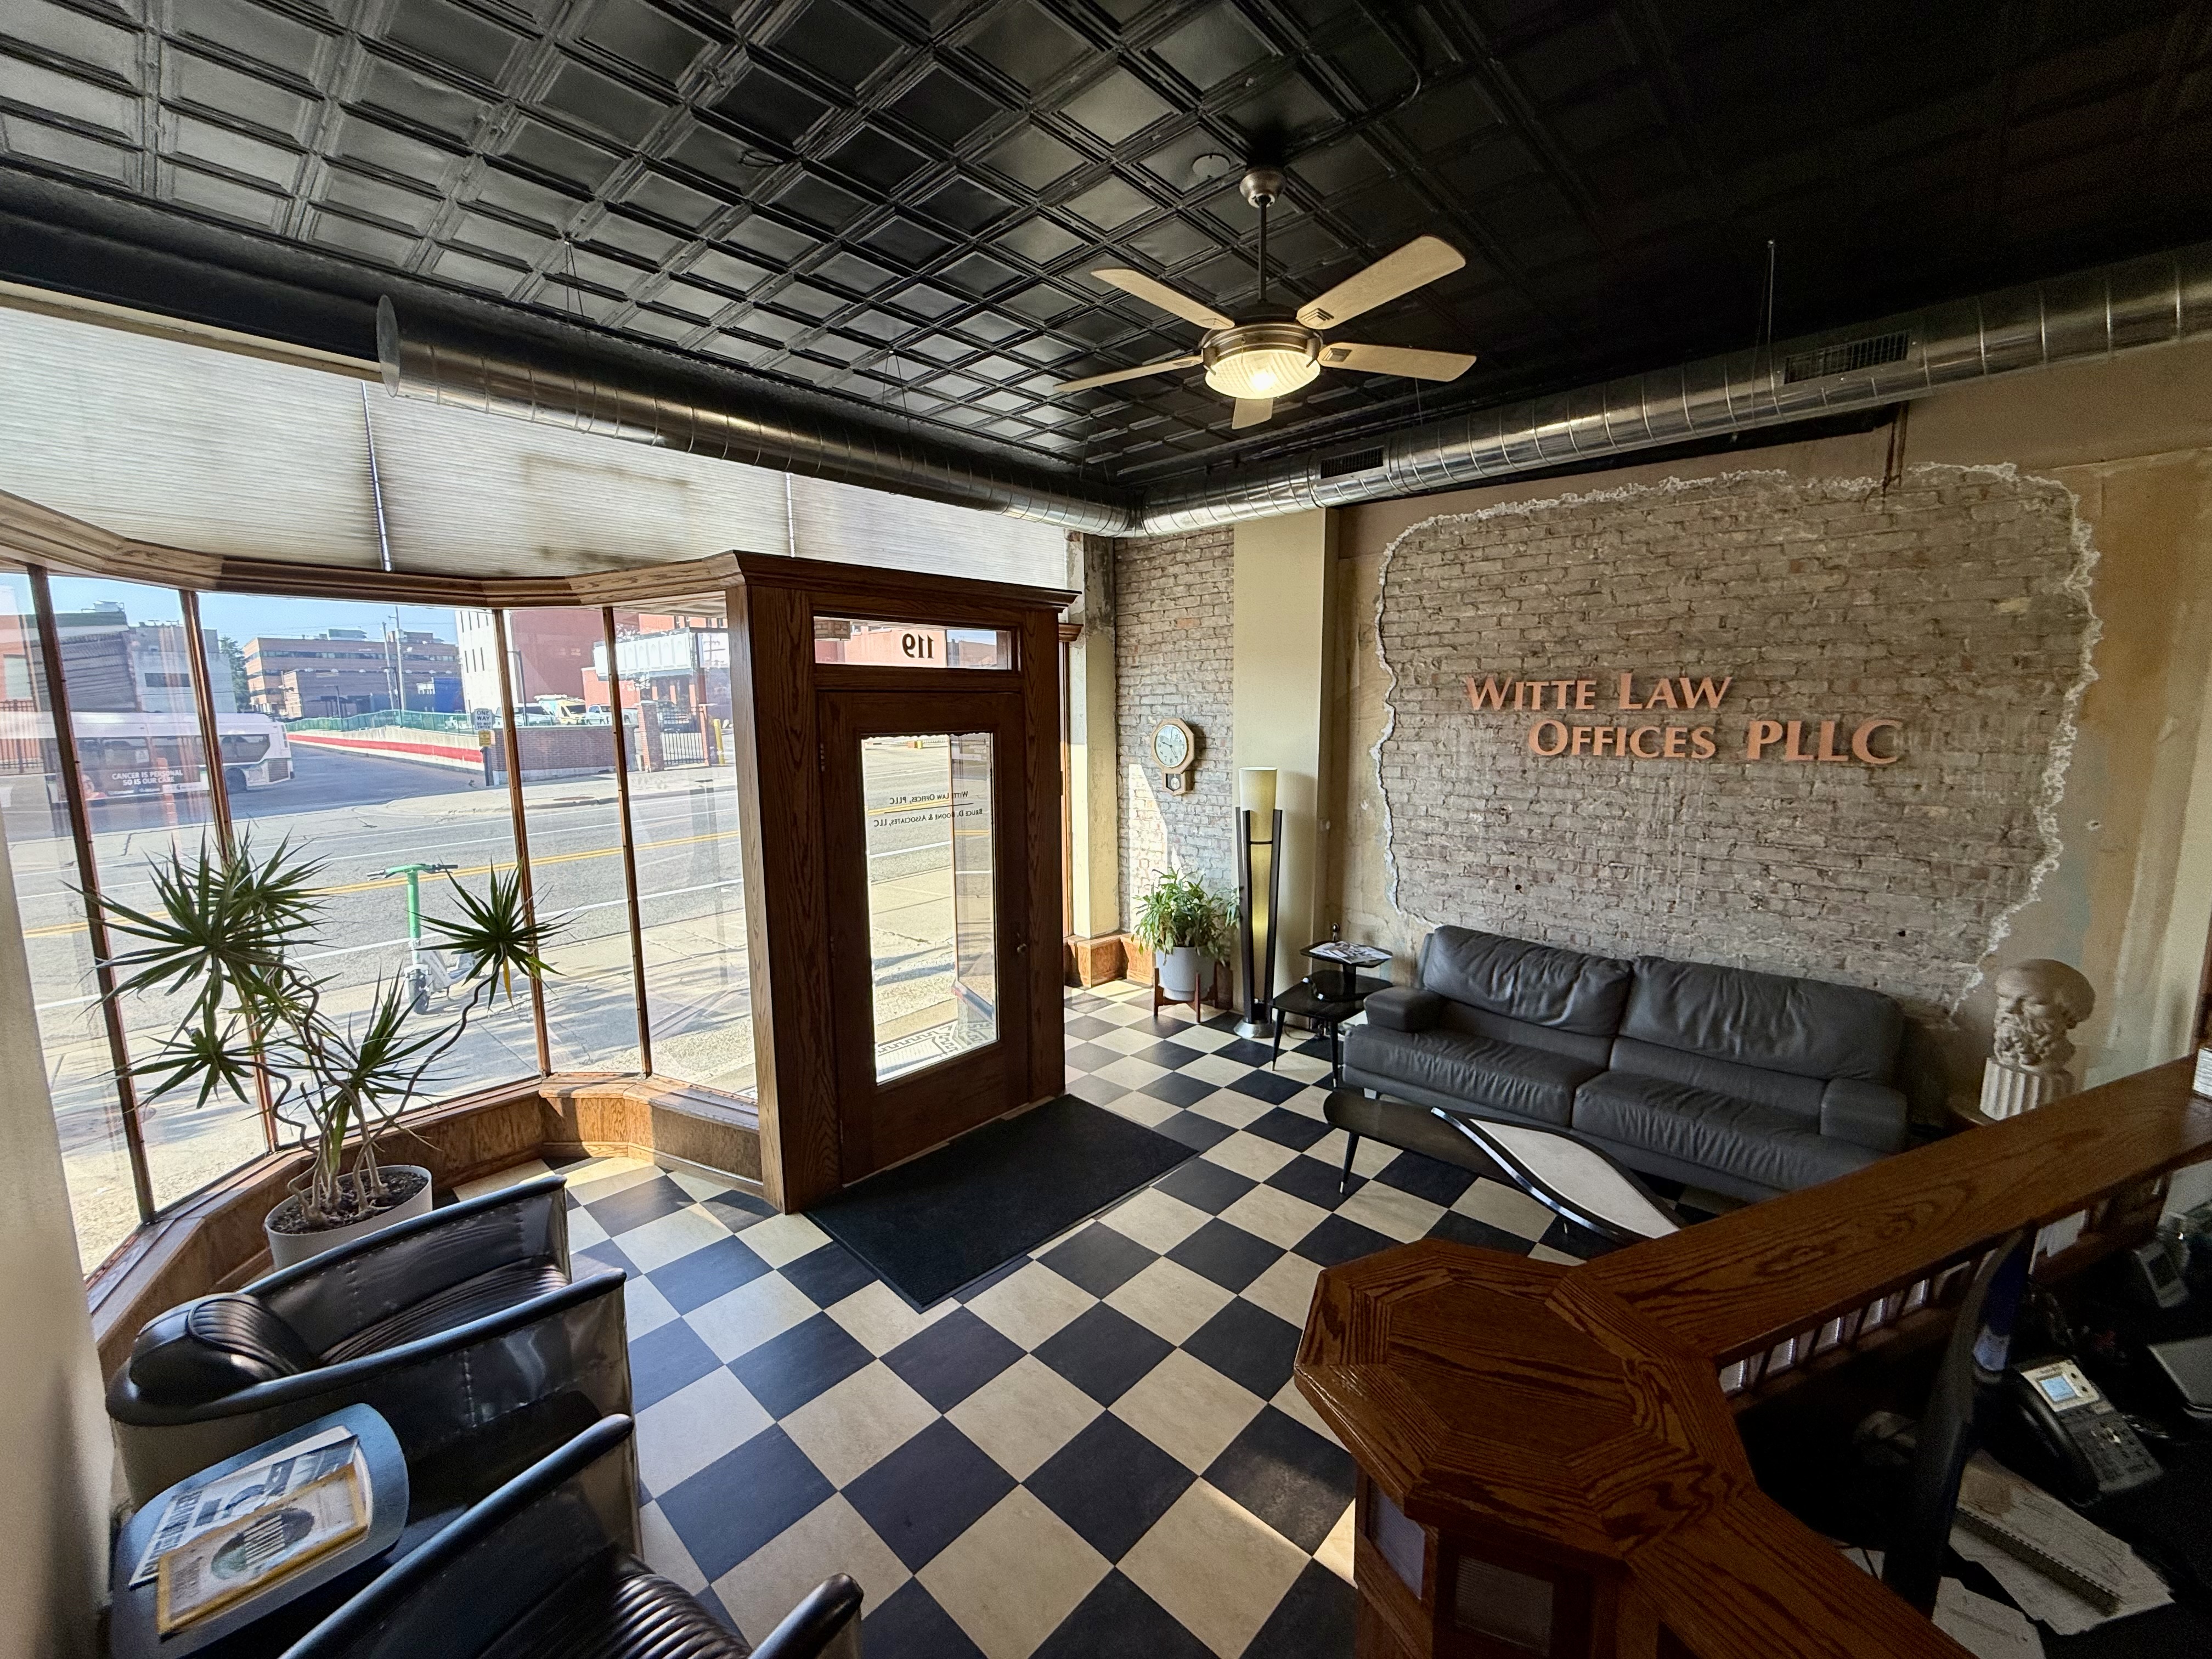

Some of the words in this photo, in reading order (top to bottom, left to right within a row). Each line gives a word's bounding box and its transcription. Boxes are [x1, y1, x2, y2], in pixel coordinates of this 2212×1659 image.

[1465, 673, 1597, 711] WITTE
[1619, 673, 1733, 710] LAW
[1528, 719, 1716, 759] OFFICES
[1747, 719, 1903, 764] PLLC
[112, 772, 140, 780] CANCER
[150, 770, 183, 778] PERSONAL
